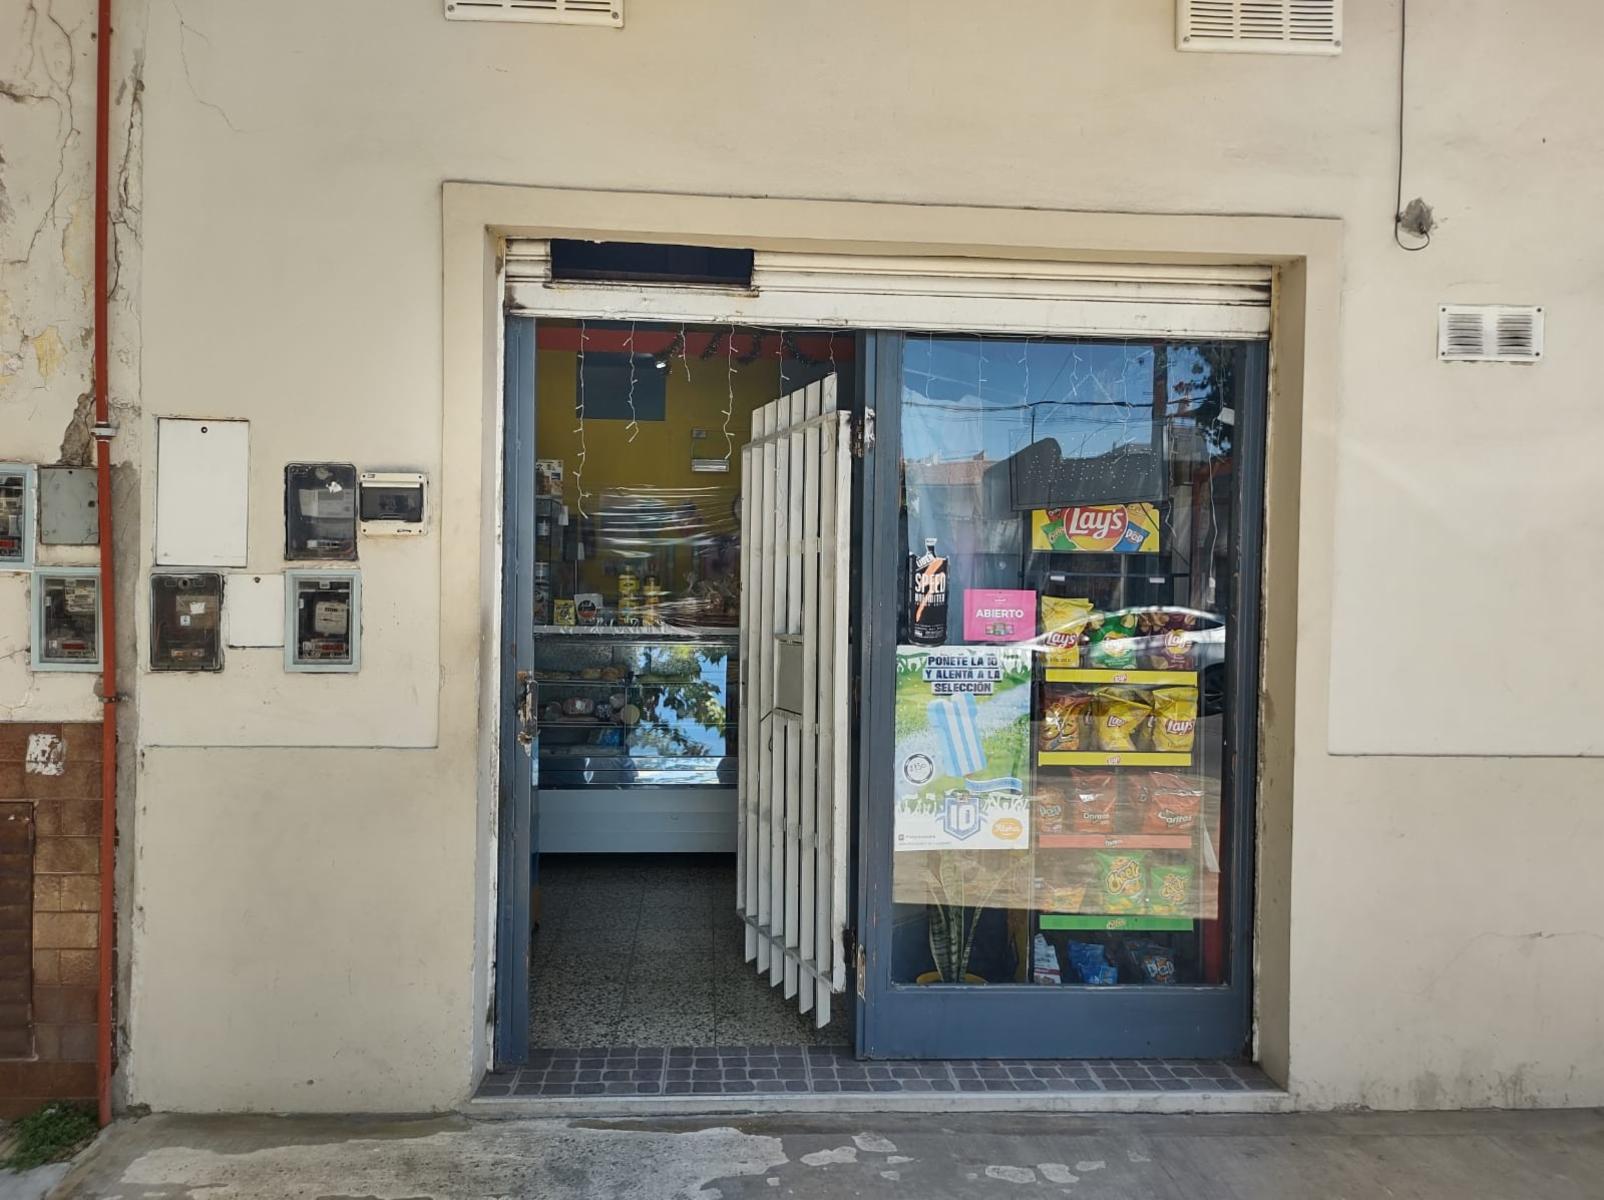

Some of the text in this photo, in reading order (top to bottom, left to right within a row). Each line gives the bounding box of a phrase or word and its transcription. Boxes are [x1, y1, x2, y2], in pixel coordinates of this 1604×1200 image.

[1069, 507, 1124, 539] Lay's
[914, 573, 946, 593] SPEED
[975, 608, 1024, 618] ABIERTO
[928, 656, 967, 666] PONETE
[971, 656, 984, 666] LA
[925, 670, 932, 679] Y
[977, 670, 984, 679] A
[988, 670, 1000, 679] LA
